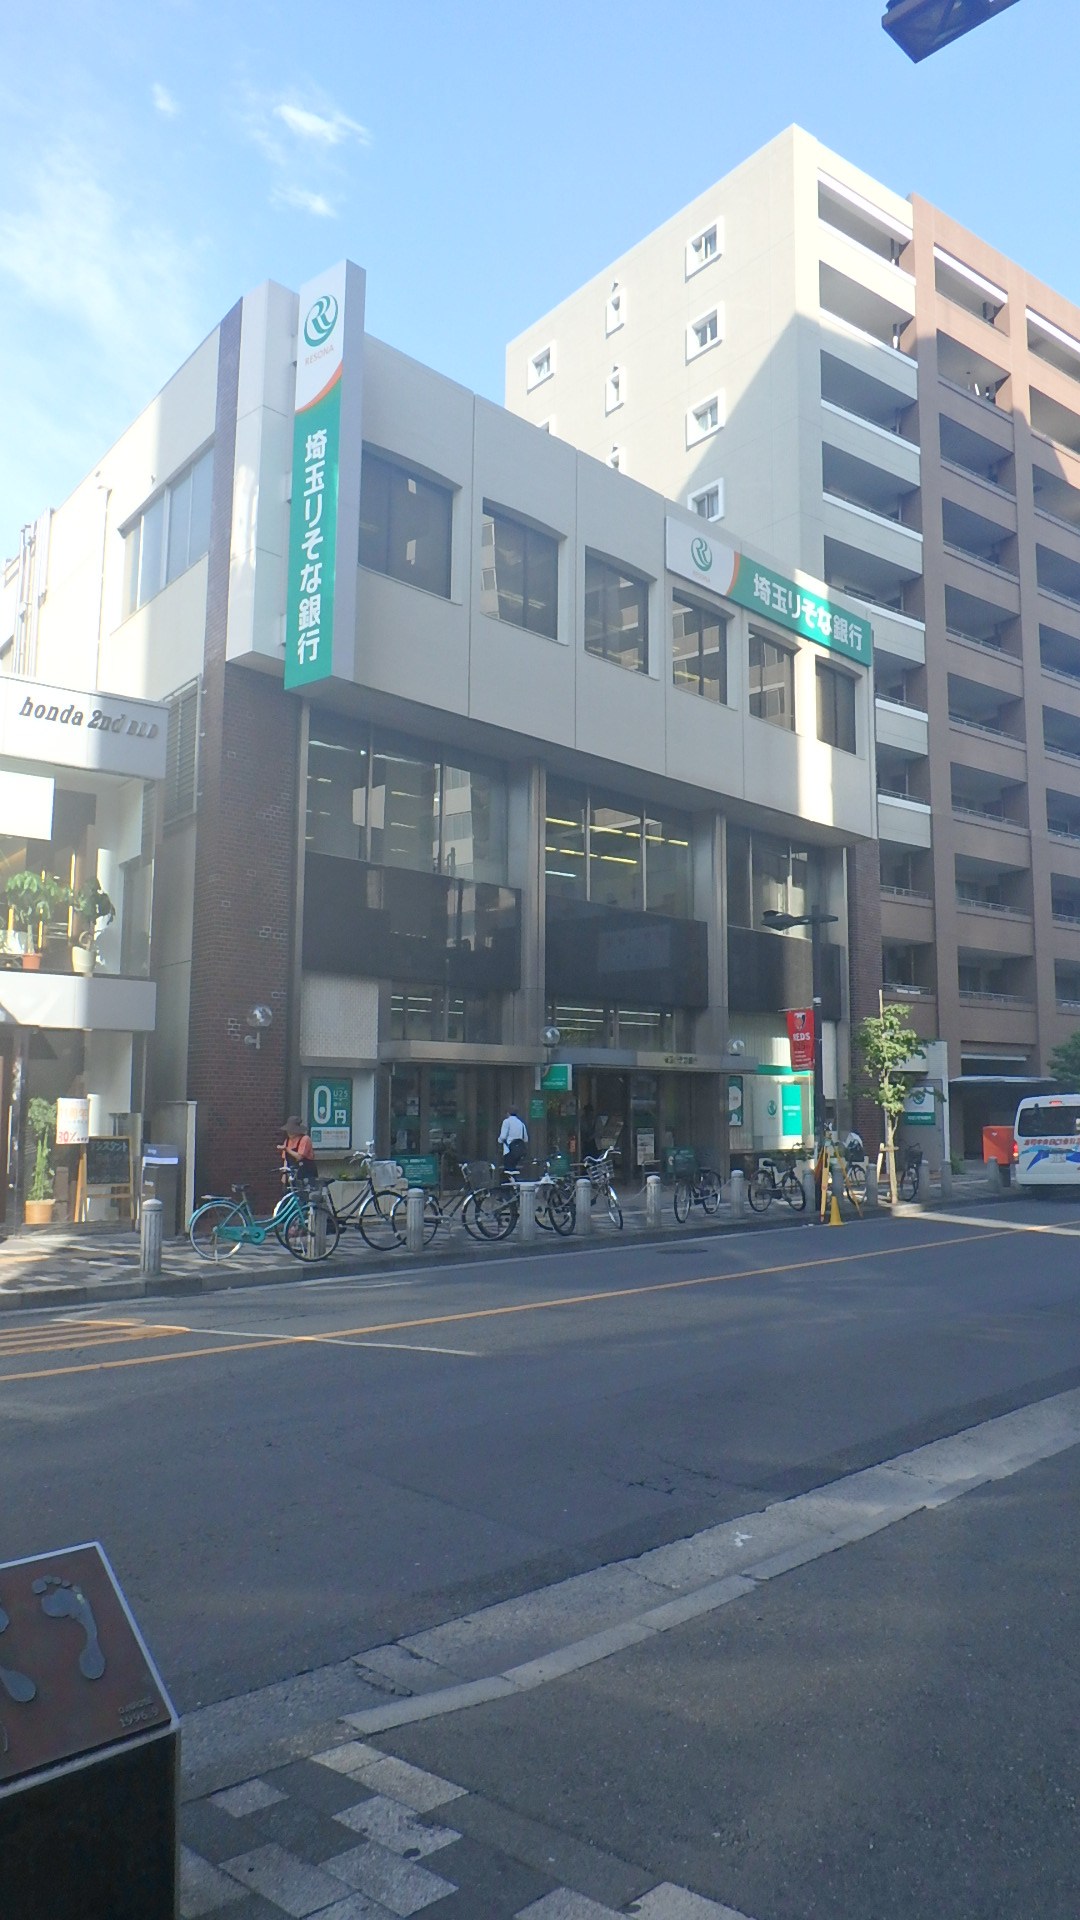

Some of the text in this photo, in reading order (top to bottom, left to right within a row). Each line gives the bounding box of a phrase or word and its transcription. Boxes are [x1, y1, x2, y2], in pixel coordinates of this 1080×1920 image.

[304, 345, 334, 366] RESONA
[297, 429, 328, 664] 埼玉りそな銀行
[753, 572, 863, 651] 埼玉りそな銀行
[19, 696, 84, 726] honda
[87, 709, 127, 733] 2nd
